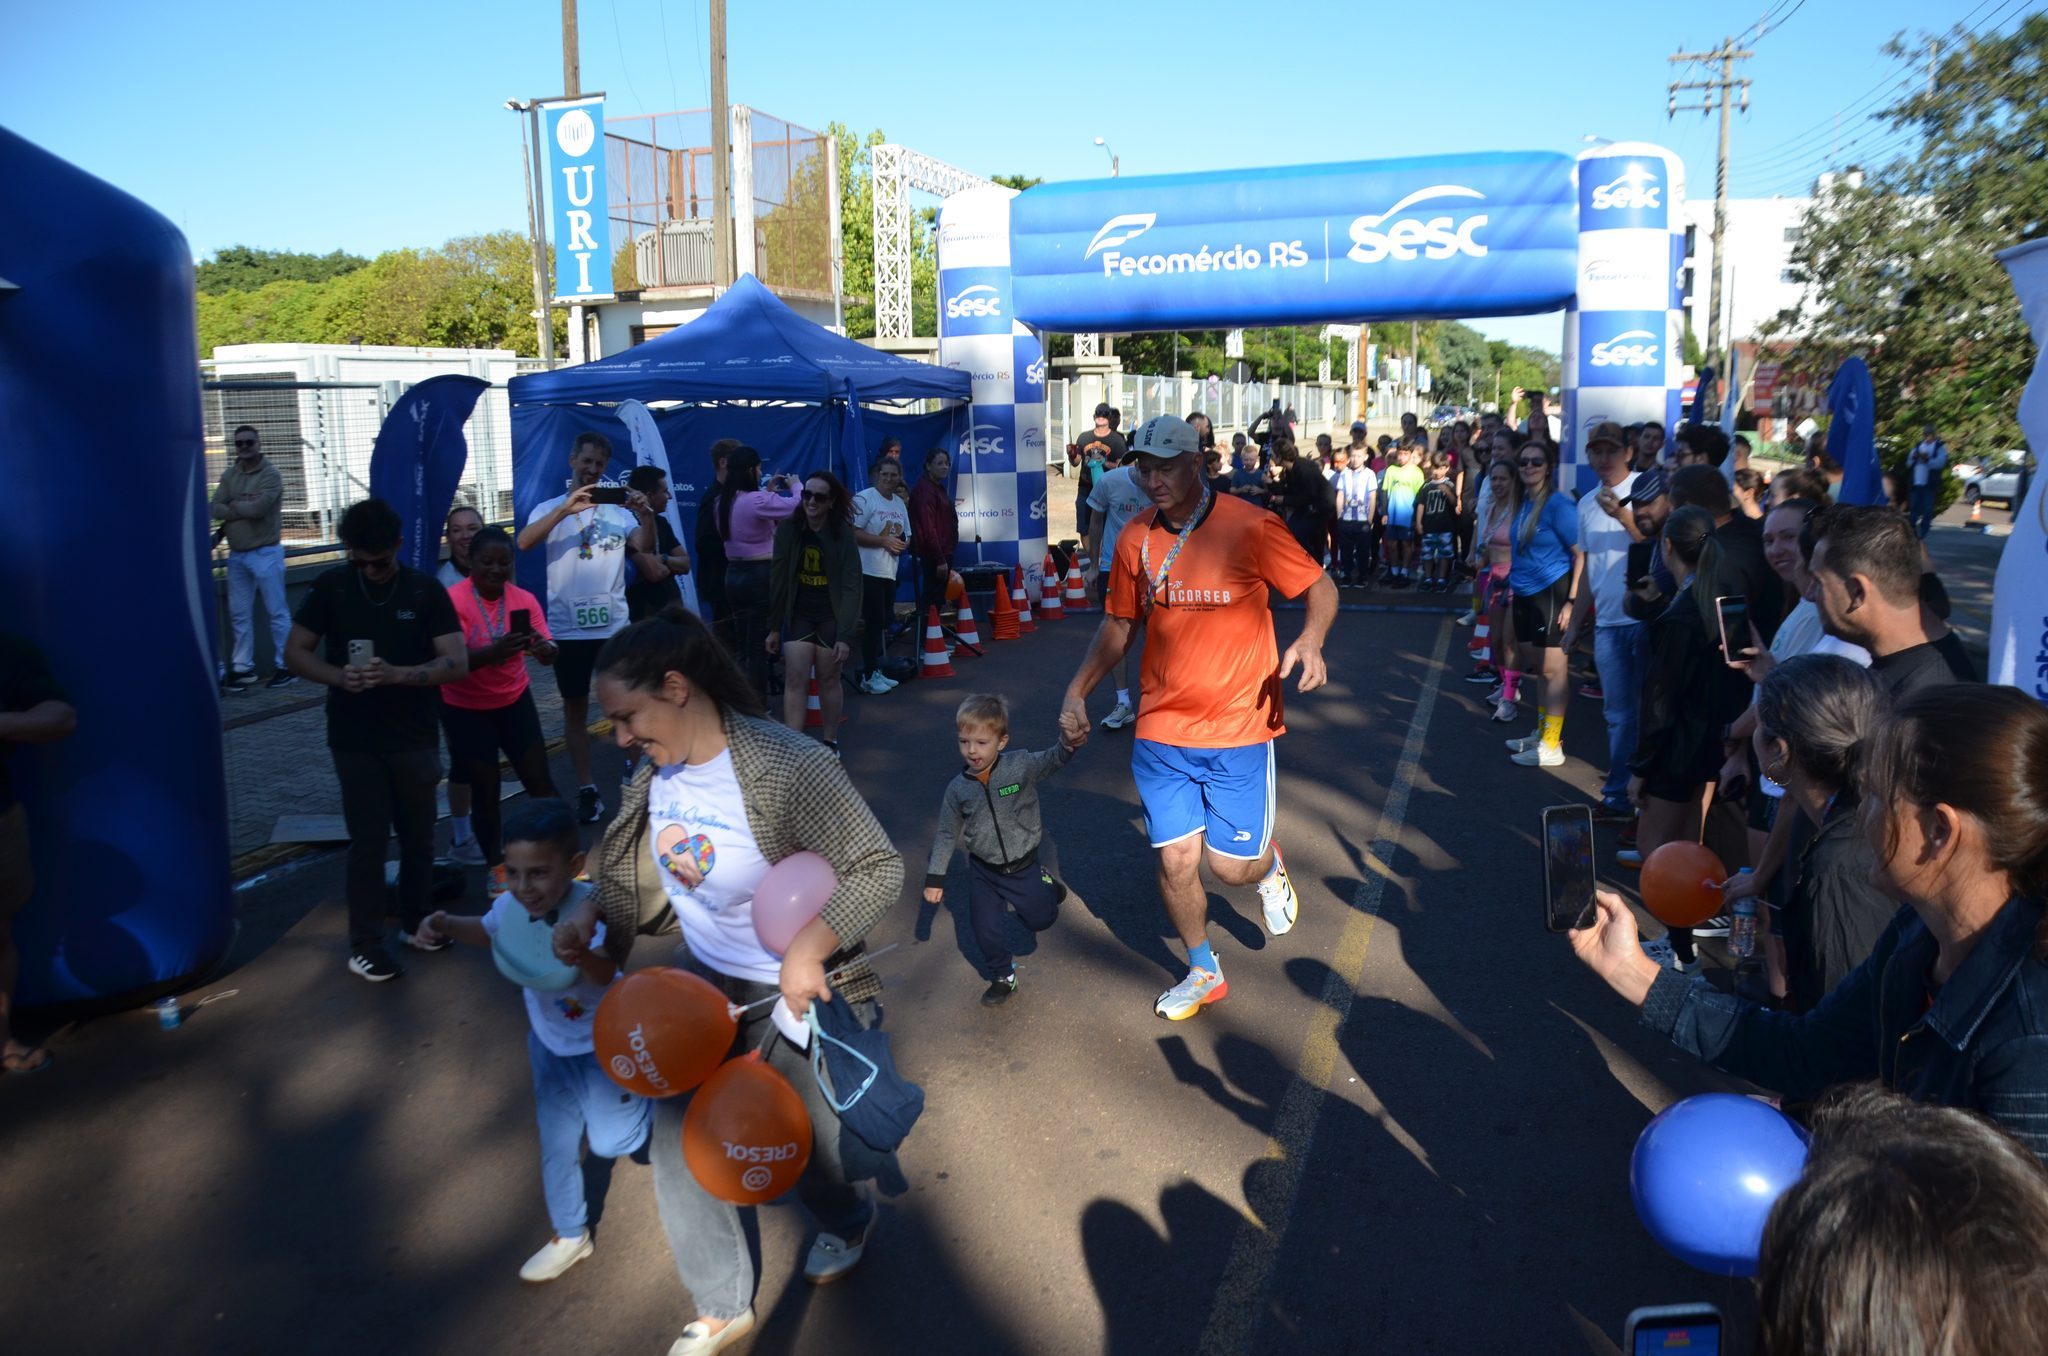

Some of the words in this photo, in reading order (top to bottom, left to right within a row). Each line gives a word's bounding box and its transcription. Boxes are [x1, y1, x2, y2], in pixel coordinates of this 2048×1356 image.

[562, 164, 599, 293] URI
[1346, 212, 1489, 264] Sesc
[1102, 243, 1262, 278] Fecomércio
[1269, 240, 1309, 268] RS
[947, 296, 1000, 319] Sesc
[1590, 341, 1659, 366] Sesc
[1001, 509, 1014, 517] RS
[1169, 589, 1231, 603] ACORSEB
[576, 606, 609, 626] 566
[627, 1022, 669, 1090] CRESOL
[722, 1141, 798, 1163] CRESOL
